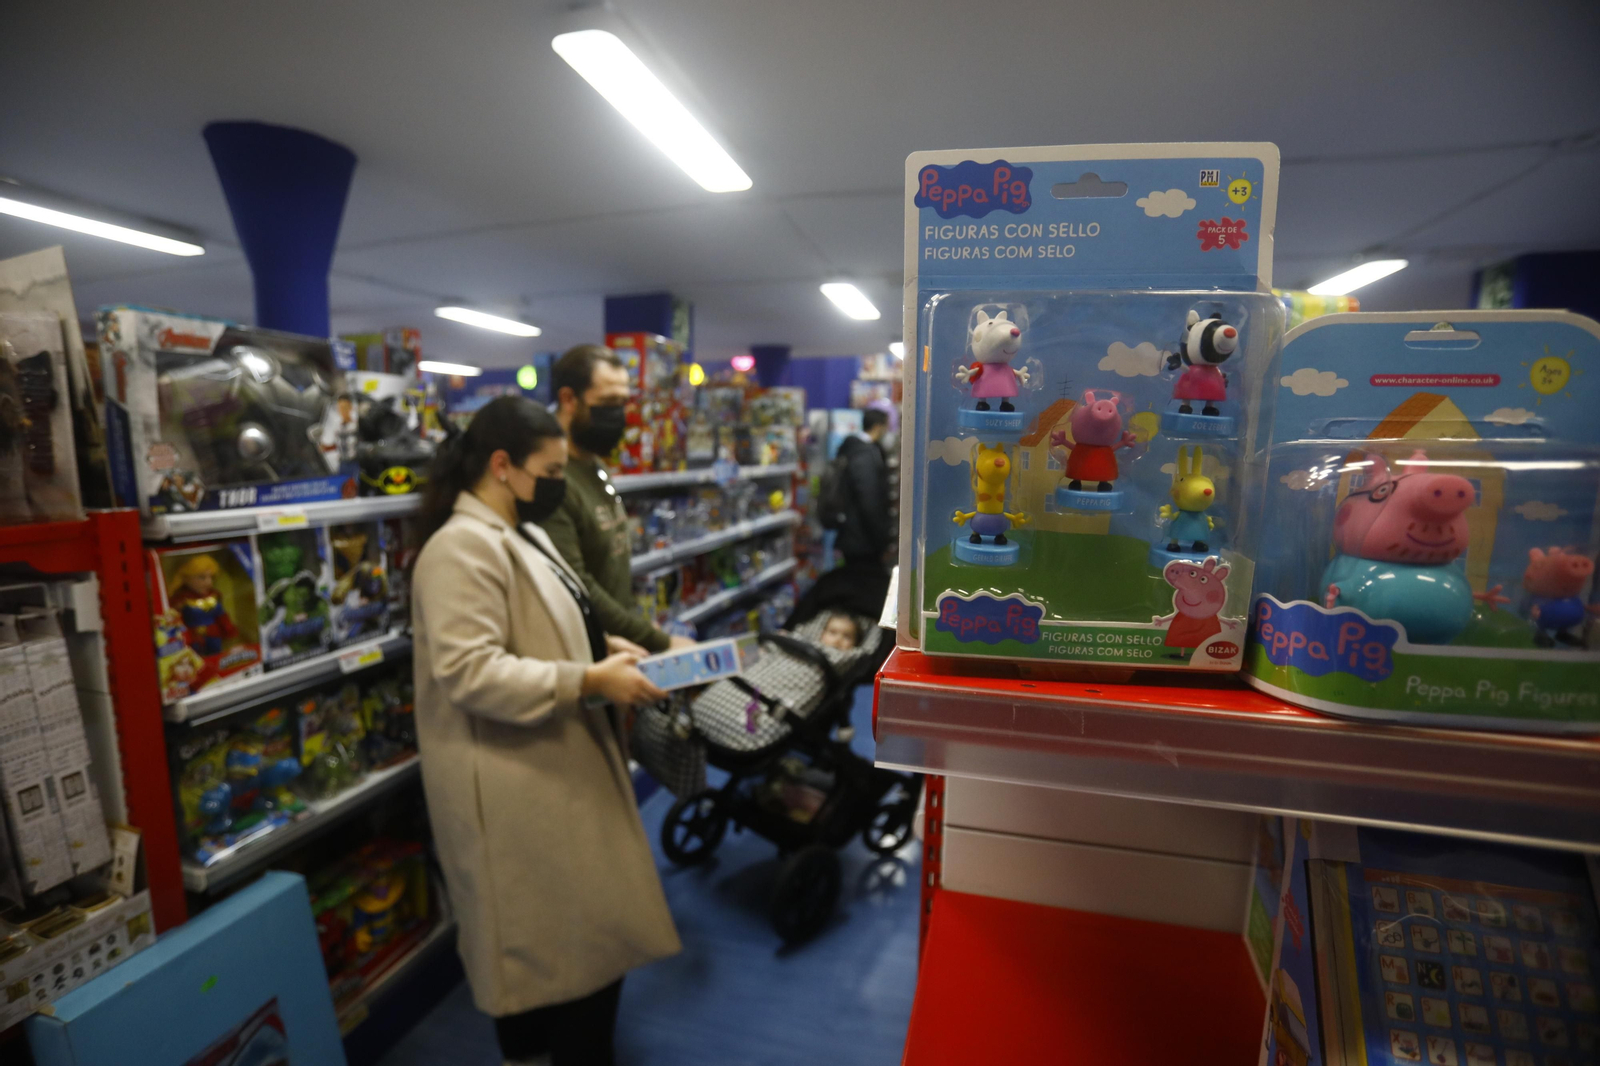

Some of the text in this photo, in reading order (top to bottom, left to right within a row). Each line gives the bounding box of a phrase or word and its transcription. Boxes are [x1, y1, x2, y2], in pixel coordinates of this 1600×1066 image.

[920, 166, 1028, 211] Peppa Pig
[1231, 186, 1248, 197] +3
[924, 221, 1101, 241] FIGURAS CON SELLO
[1207, 226, 1226, 234] PACK
[1218, 234, 1226, 245] 5
[924, 244, 1076, 261] FIGURAS COM SELO
[1374, 376, 1495, 385] www.character-online.co.uk
[985, 418, 1003, 426] SUZY
[1076, 497, 1111, 507] PEPPA PIG
[941, 600, 1037, 637] Peppa Pig
[1042, 631, 1163, 646] FIGURAS CON SELLO
[1255, 601, 1388, 670] Peppa Pig
[1048, 645, 1153, 658] FIGURAS COM SELO
[1207, 645, 1238, 655] BIZAK
[1405, 675, 1467, 703] Peppa
[1476, 680, 1509, 706] Pig
